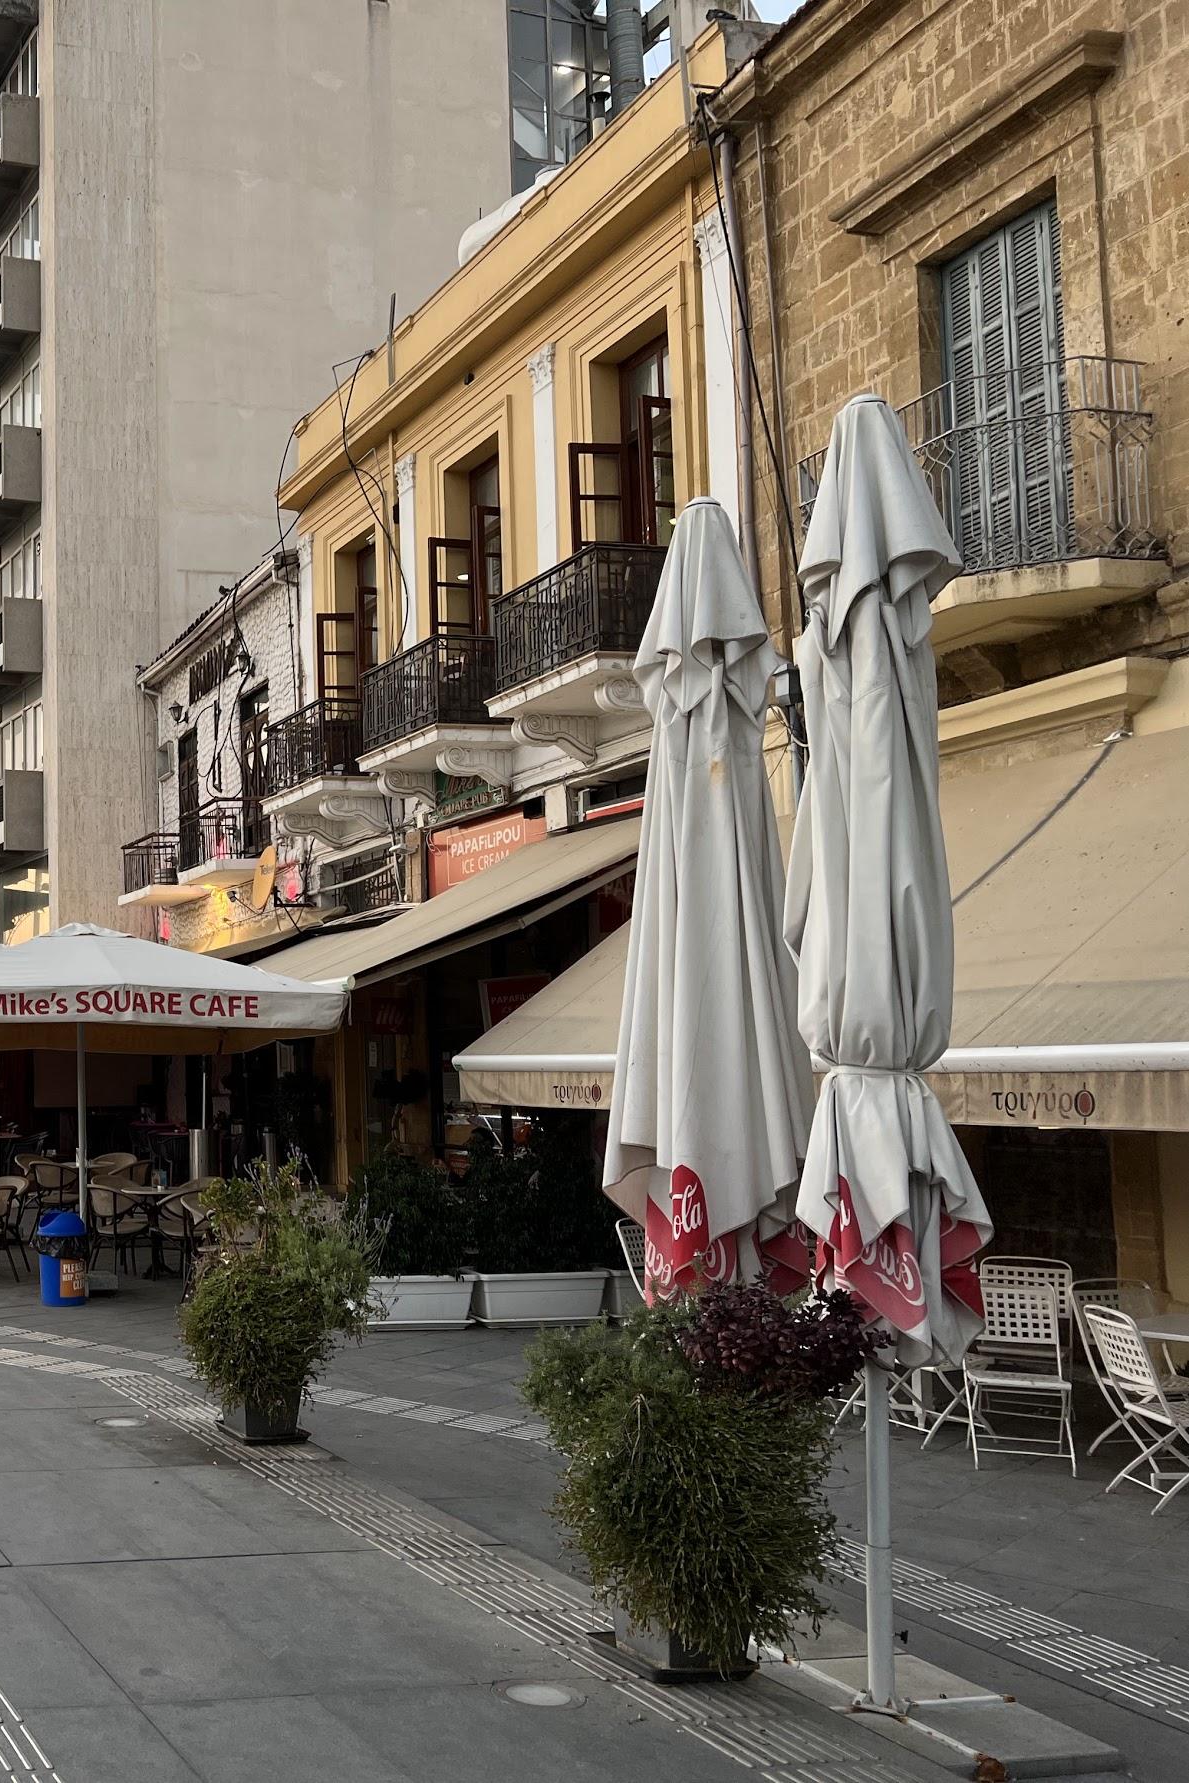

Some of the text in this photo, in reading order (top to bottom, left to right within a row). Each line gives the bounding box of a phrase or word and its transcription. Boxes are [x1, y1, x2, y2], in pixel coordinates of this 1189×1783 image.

[462, 859, 475, 875] ICE
[75, 990, 182, 1016] SQUARE
[189, 994, 259, 1018] CAFE
